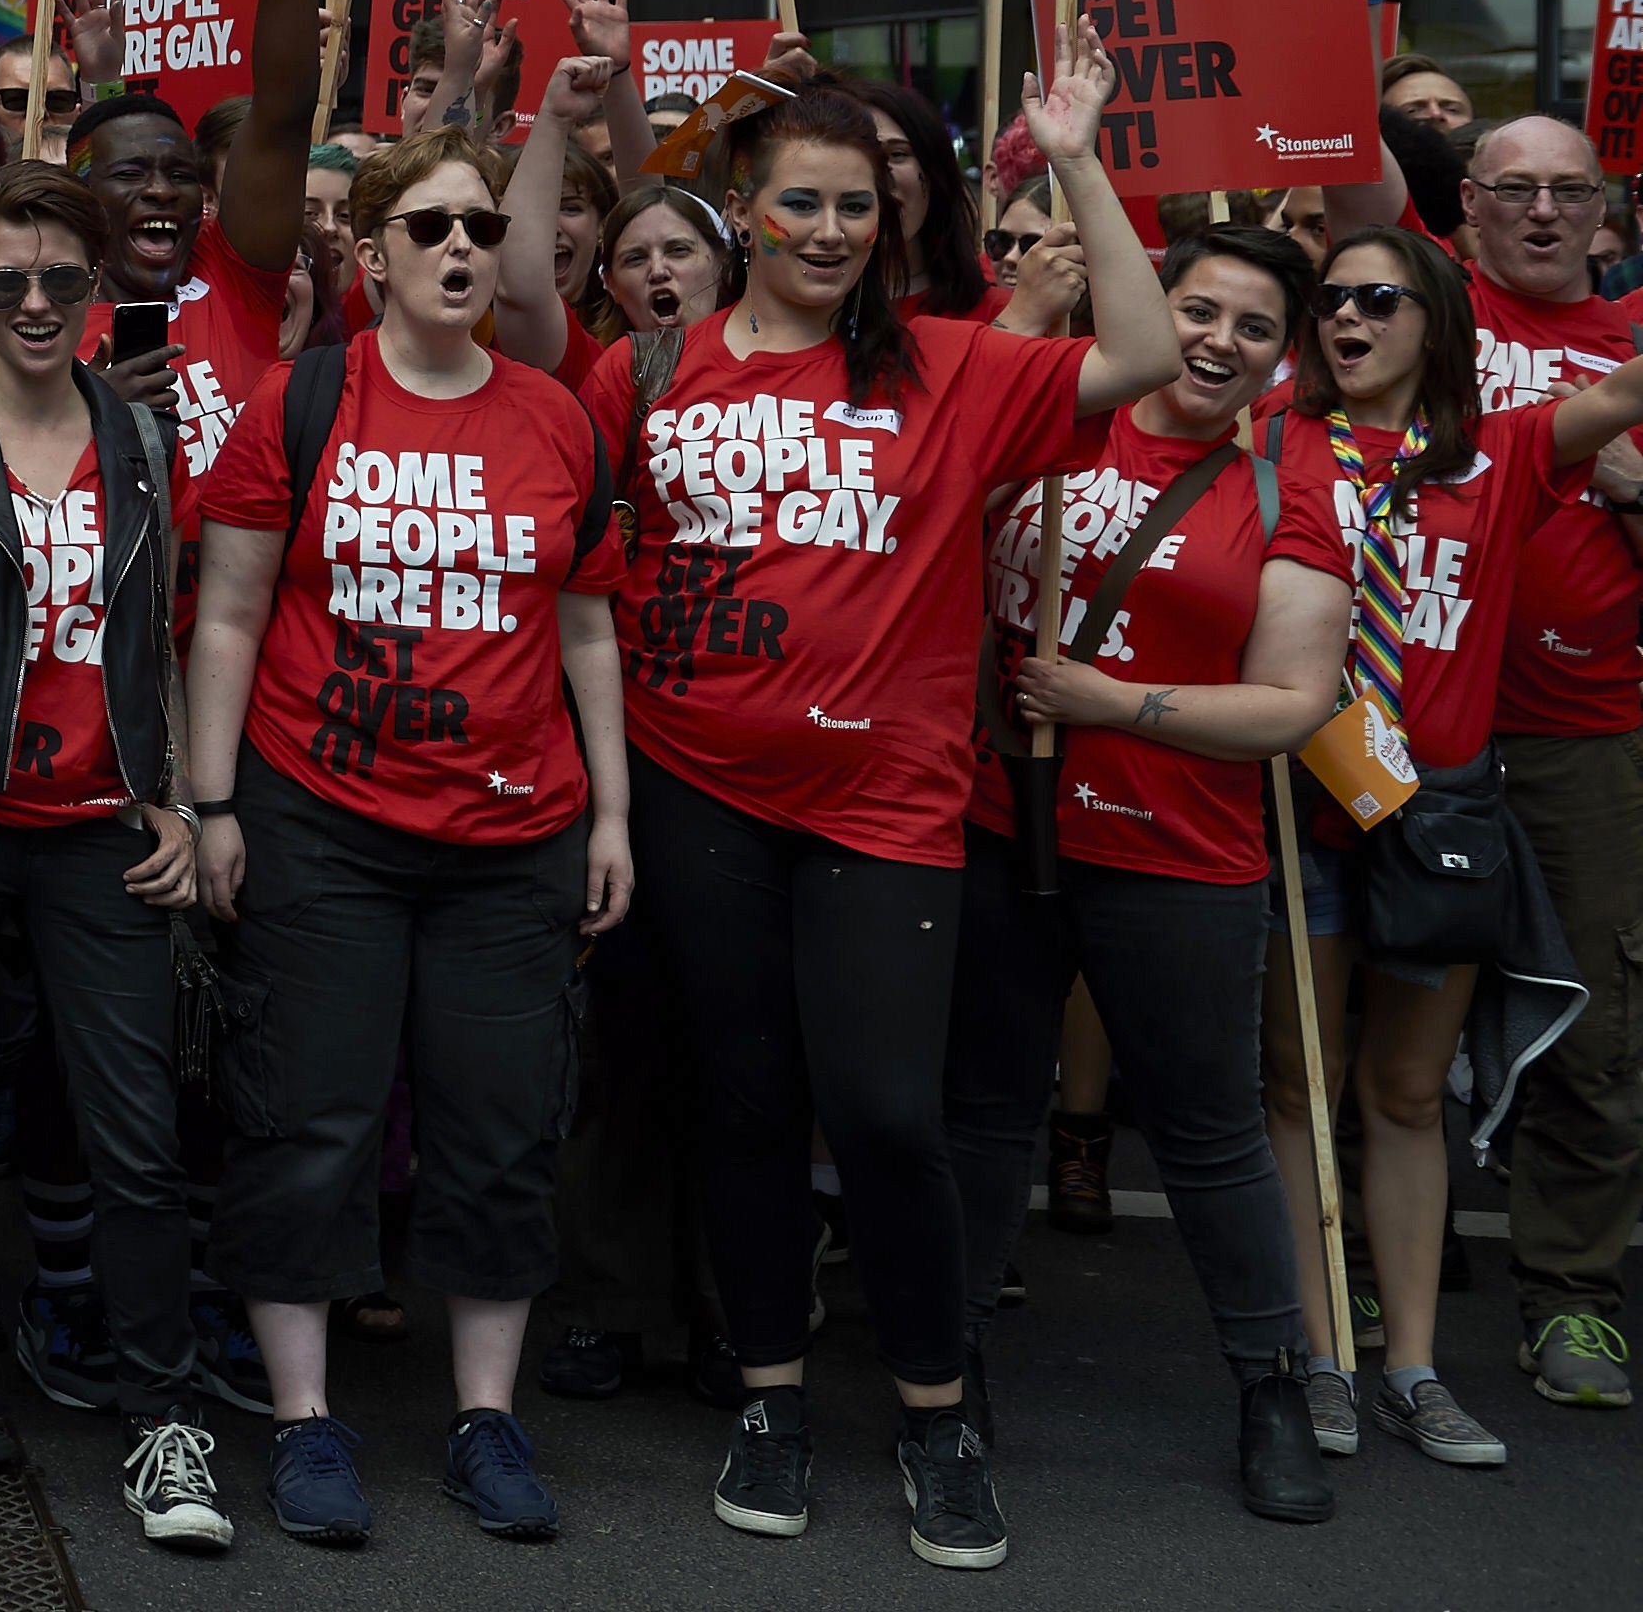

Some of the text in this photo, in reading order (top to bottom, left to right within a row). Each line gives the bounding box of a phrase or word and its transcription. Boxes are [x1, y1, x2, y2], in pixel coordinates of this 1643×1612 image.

[165, 19, 241, 71] GAY.
[643, 38, 734, 73] SOME
[1276, 134, 1353, 152] Stonewall
[646, 393, 815, 454] SOME
[328, 441, 487, 511] SOME
[648, 437, 875, 502] PEOPLE
[323, 501, 537, 574] PEOPLE
[666, 488, 901, 556] ARE GAY.
[328, 564, 518, 633] ARE BI.
[656, 541, 752, 599] GET
[333, 623, 422, 681] GET
[640, 596, 789, 662] OVER
[315, 671, 470, 745] OVER
[820, 714, 870, 731] Stonewall
[1091, 797, 1153, 823] Stonewall
